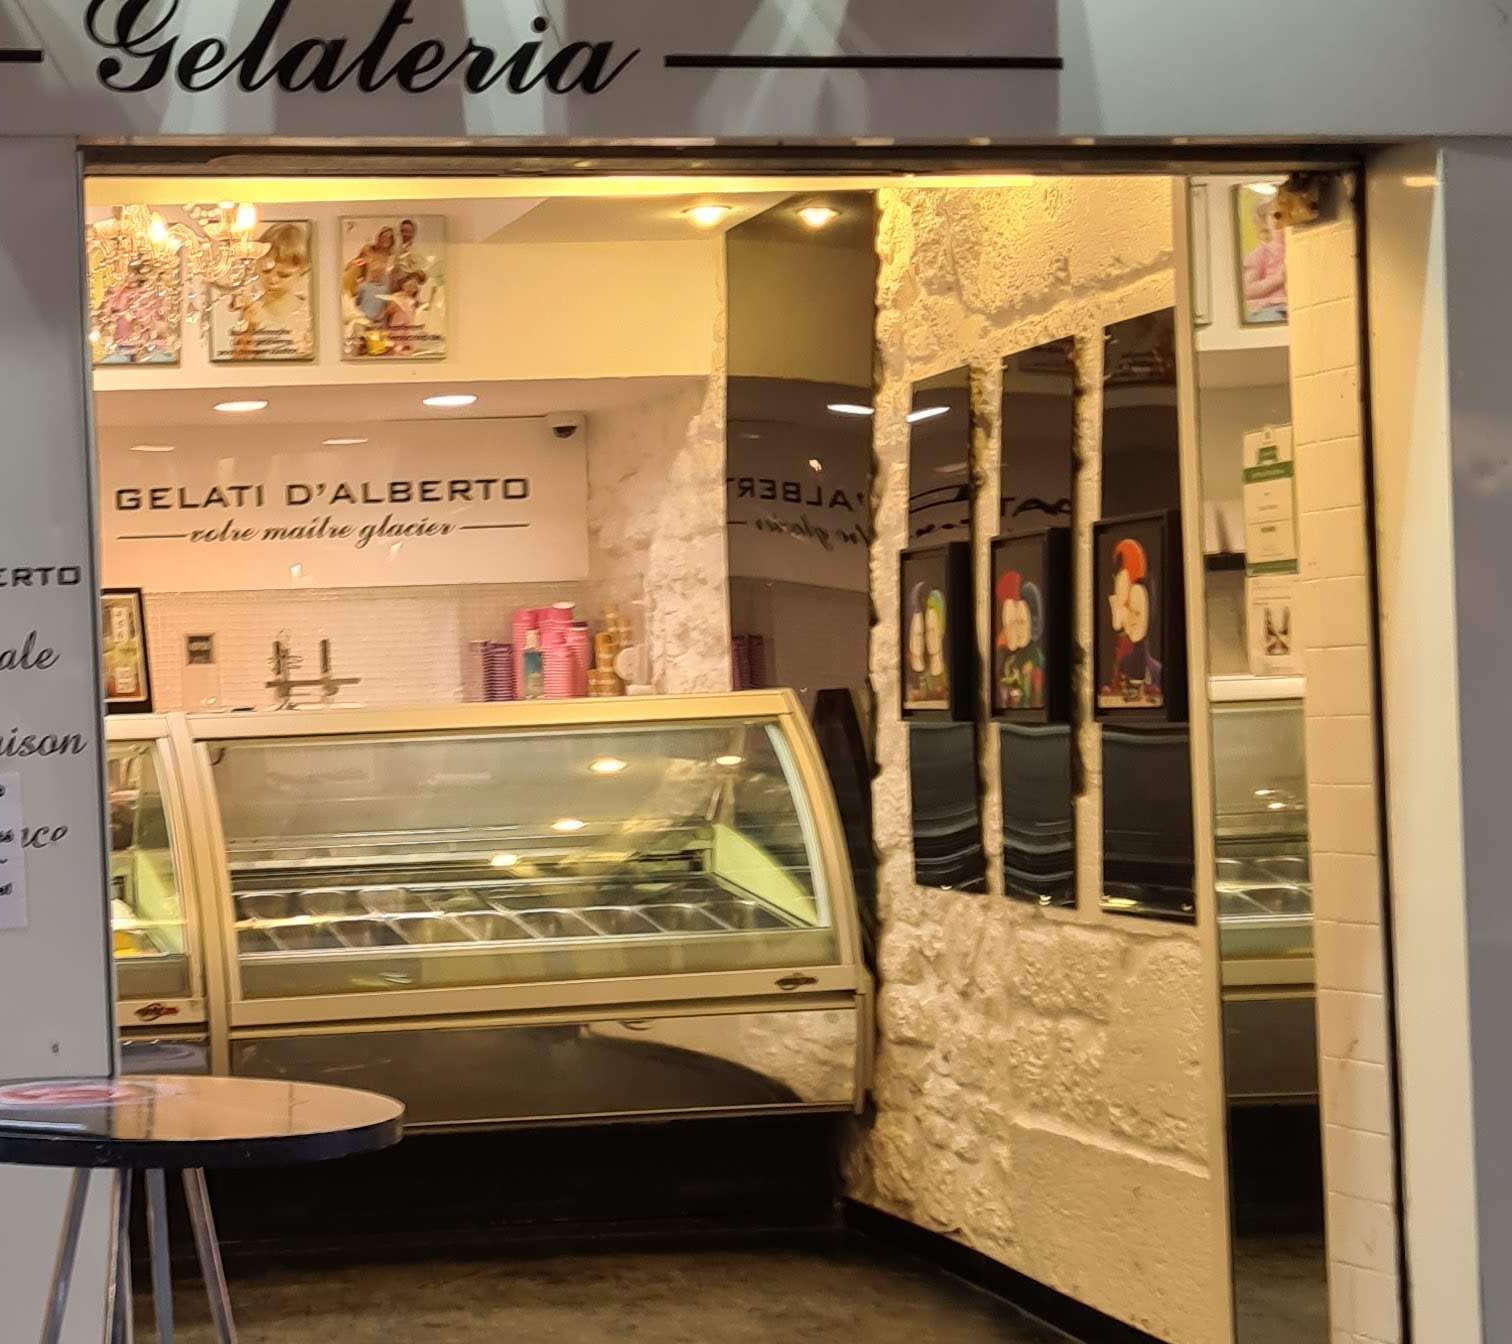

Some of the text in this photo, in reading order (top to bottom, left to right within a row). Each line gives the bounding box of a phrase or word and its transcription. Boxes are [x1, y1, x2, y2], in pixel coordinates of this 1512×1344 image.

[115, 477, 530, 511] GELATI D'ALBERTO
[354, 512, 456, 549] glacier
